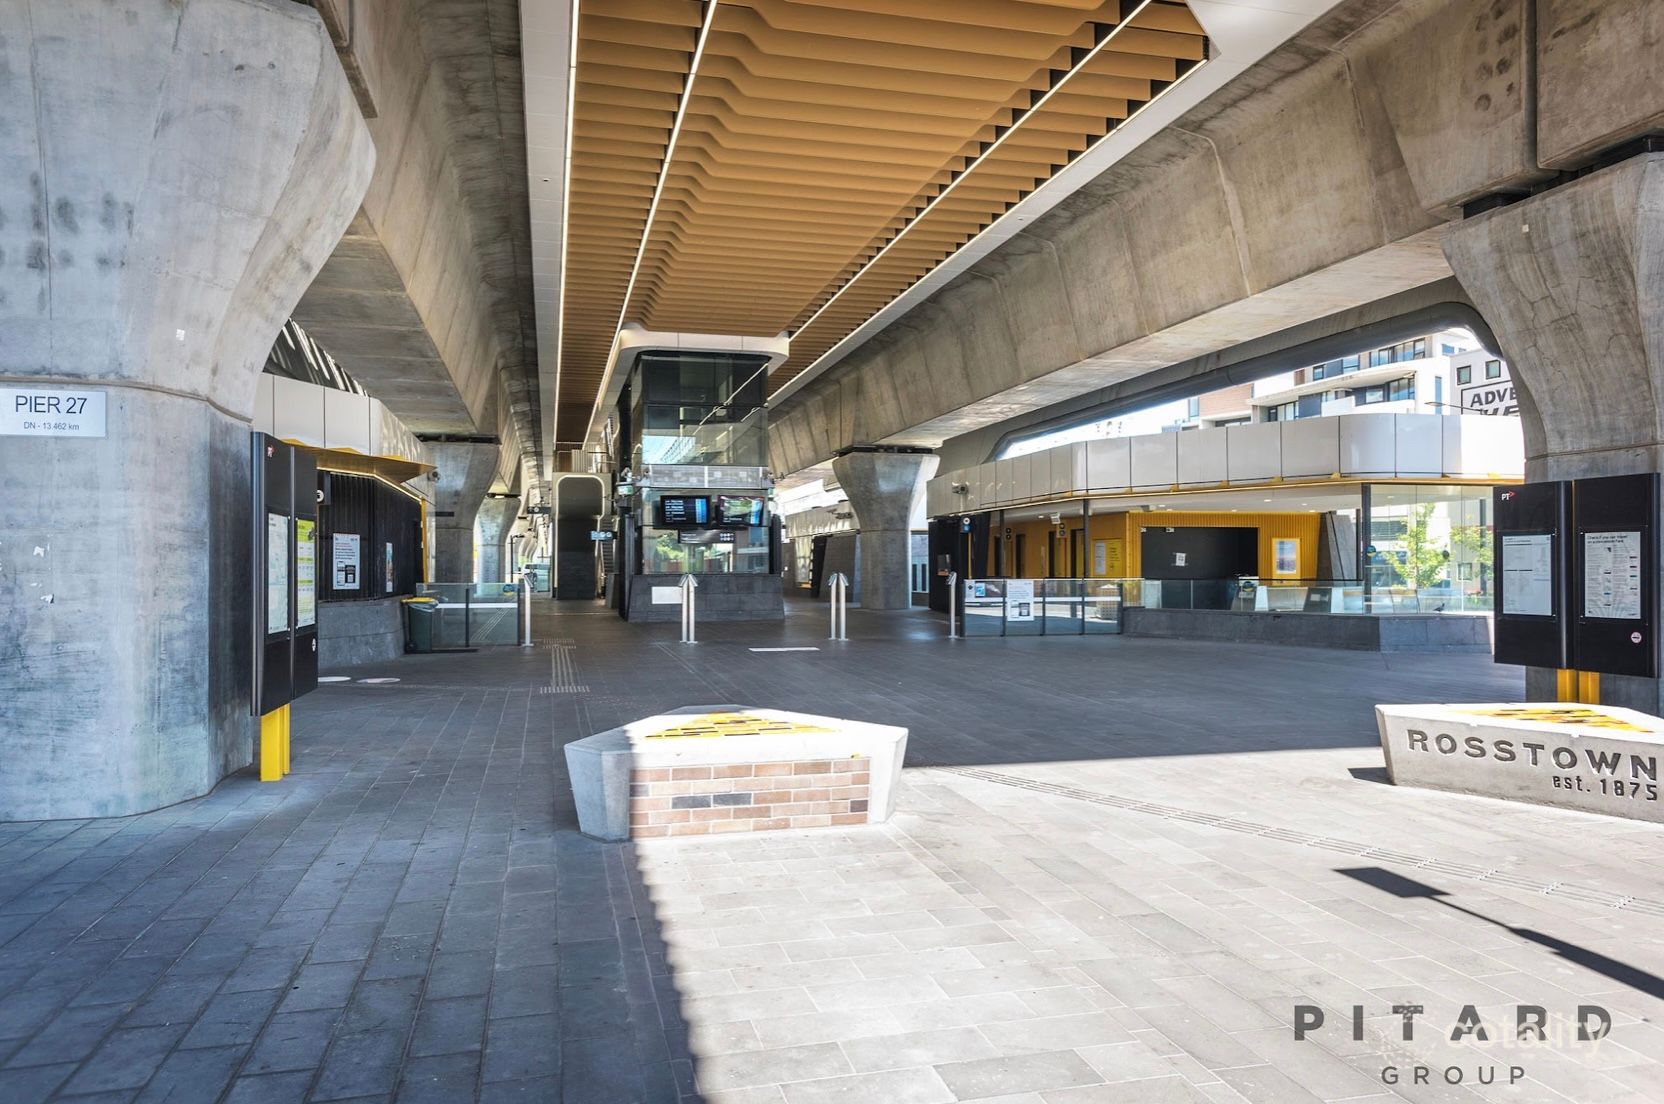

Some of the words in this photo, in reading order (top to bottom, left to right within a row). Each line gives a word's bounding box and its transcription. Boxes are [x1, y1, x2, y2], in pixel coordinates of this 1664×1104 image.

[15, 395, 61, 414] PIER
[66, 397, 88, 414] 27
[23, 421, 36, 430] DN
[68, 423, 80, 431] km
[1407, 728, 1657, 781] ROSSTOWN
[1552, 775, 1591, 793] est.
[1599, 778, 1659, 801] 1875
